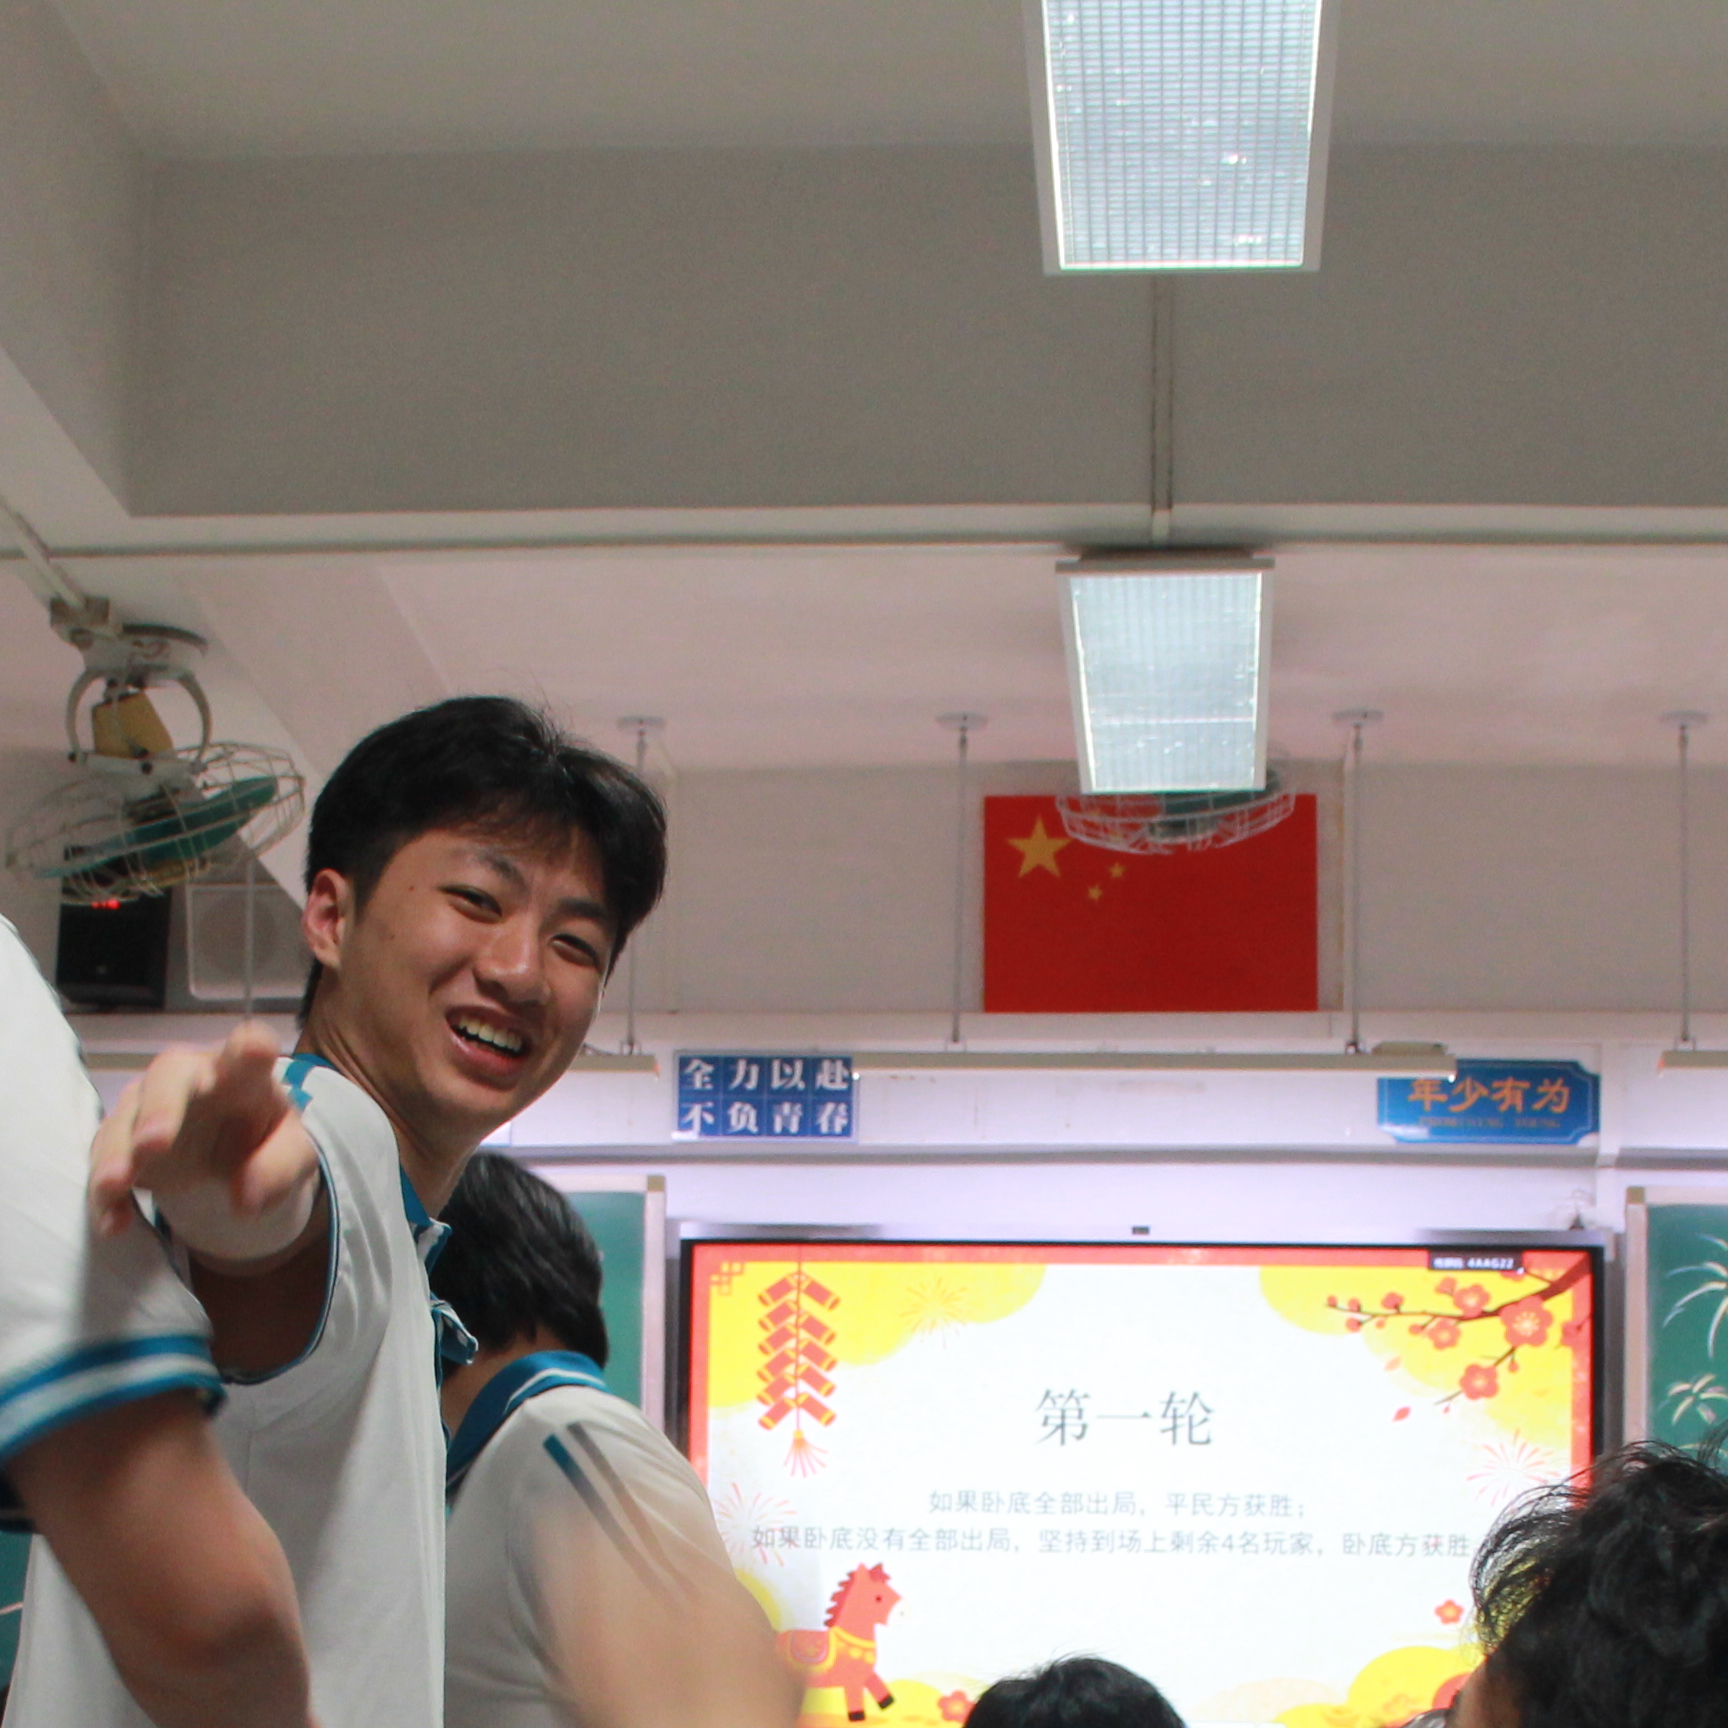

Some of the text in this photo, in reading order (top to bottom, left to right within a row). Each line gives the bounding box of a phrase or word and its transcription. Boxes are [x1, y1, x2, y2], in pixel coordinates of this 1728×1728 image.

[683, 1058, 850, 1091] 全力以赴
[1407, 1076, 1571, 1114] 年少有为
[681, 1101, 849, 1134] 不负青春
[1034, 1387, 1216, 1447] 第一轮
